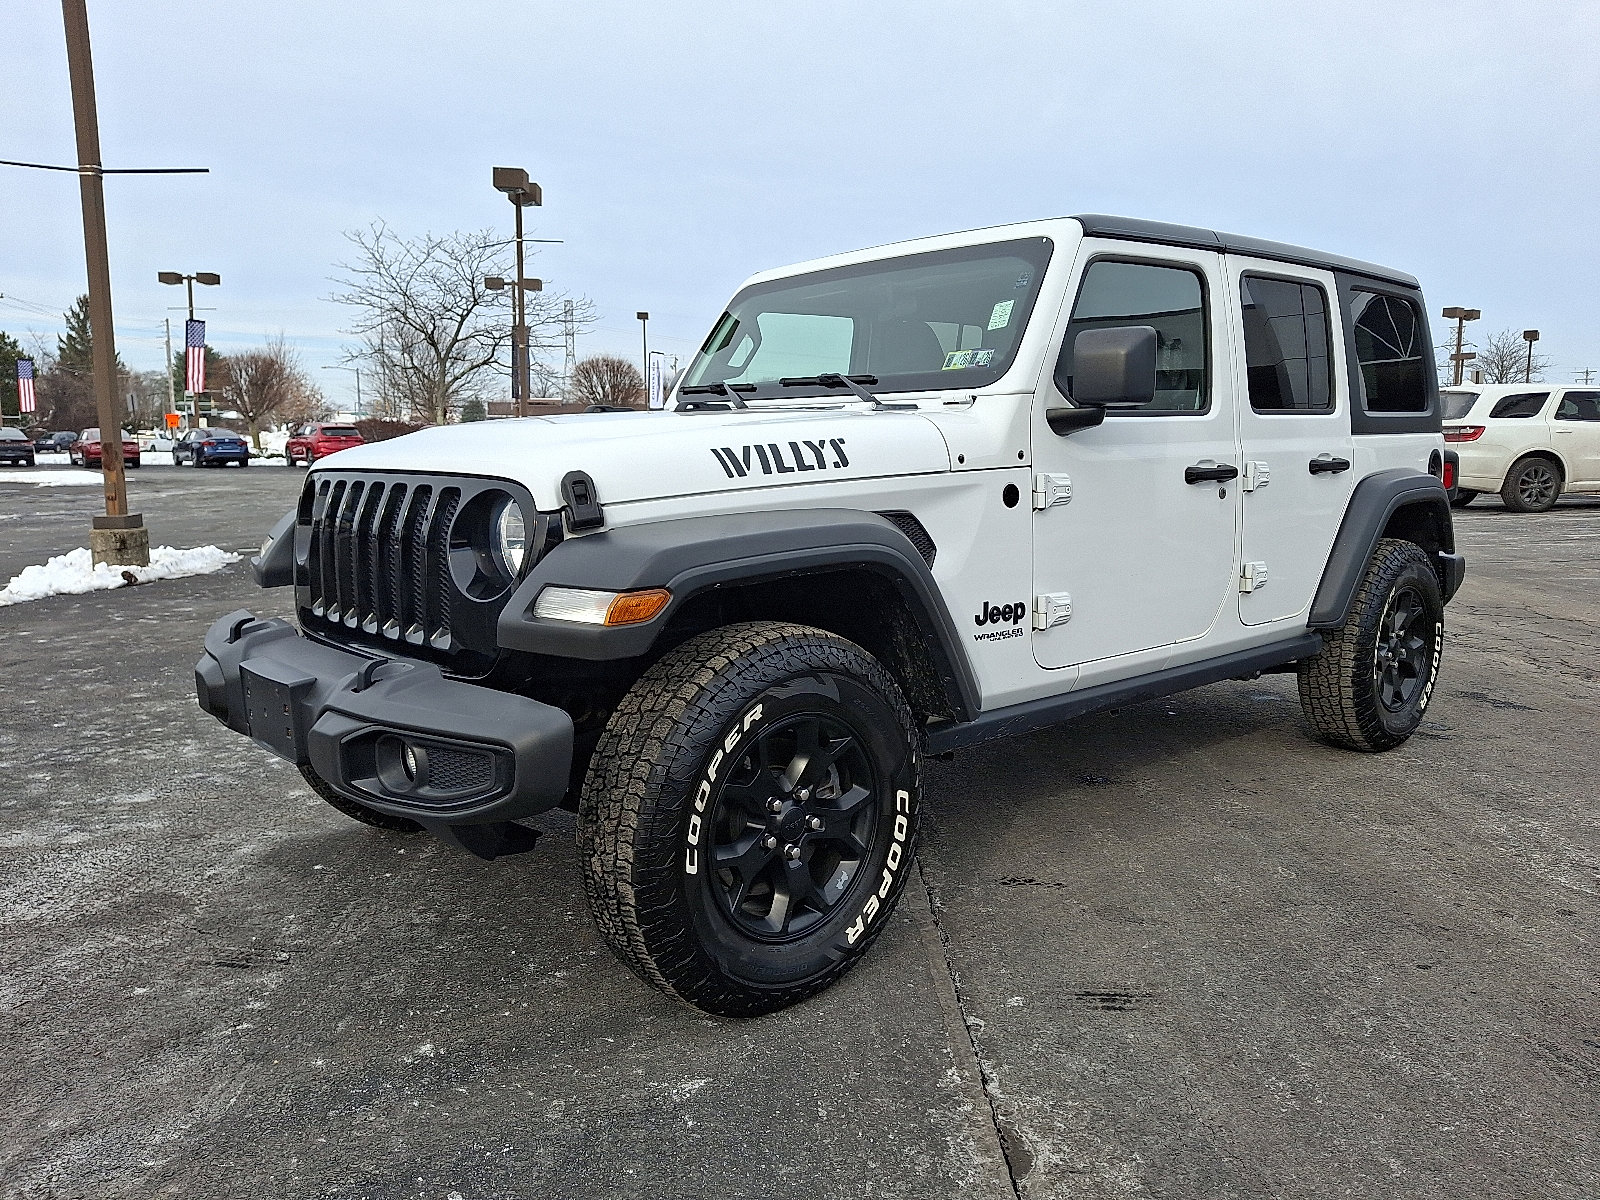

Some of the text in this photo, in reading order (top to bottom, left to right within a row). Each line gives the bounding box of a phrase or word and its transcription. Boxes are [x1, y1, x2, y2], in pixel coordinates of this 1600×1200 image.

[710, 438, 849, 478] WILLYS
[974, 601, 1026, 627] Jeep
[974, 628, 1023, 641] WRANGLER
[1420, 622, 1442, 710] COOPER
[686, 703, 763, 875] COOPER
[845, 789, 910, 945] COOPER
